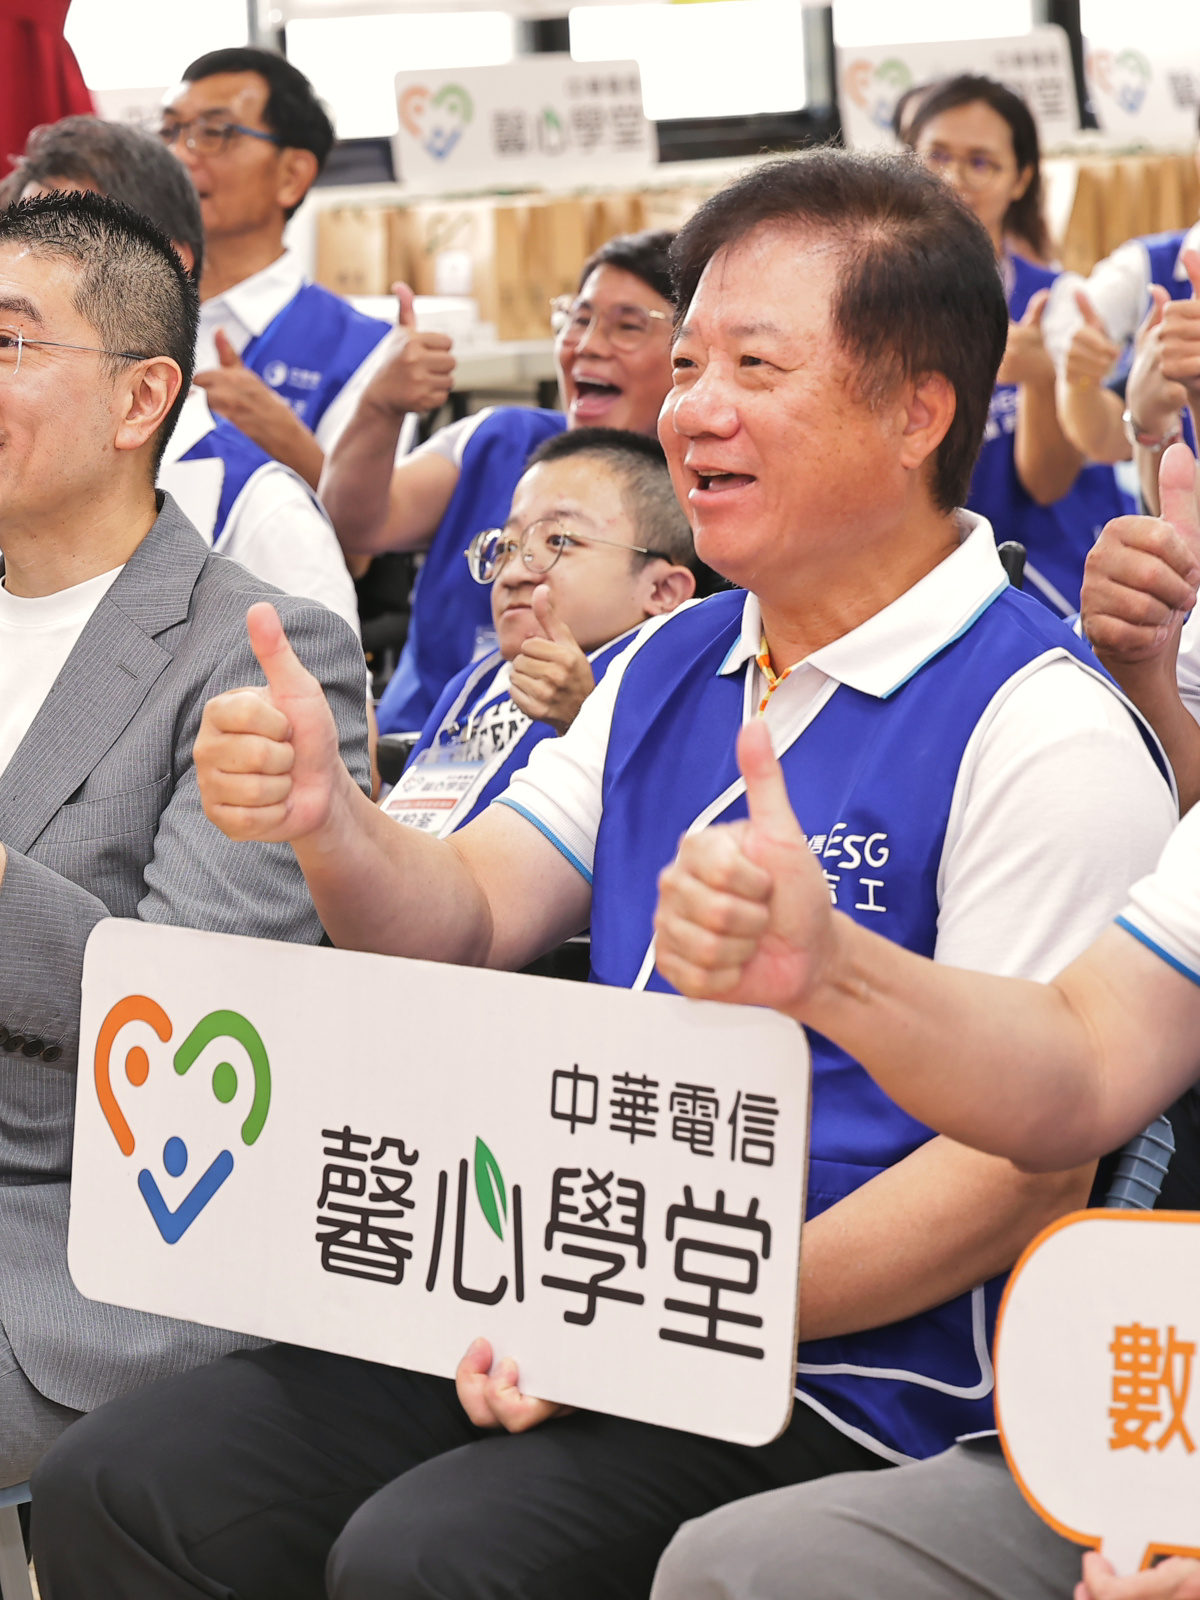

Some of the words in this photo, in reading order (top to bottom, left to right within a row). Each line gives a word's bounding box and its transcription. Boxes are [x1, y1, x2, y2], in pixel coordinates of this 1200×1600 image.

[550, 1064, 779, 1168] 中華電信
[315, 1126, 772, 1360] 馨心學堂
[1108, 1322, 1197, 1454] 數
